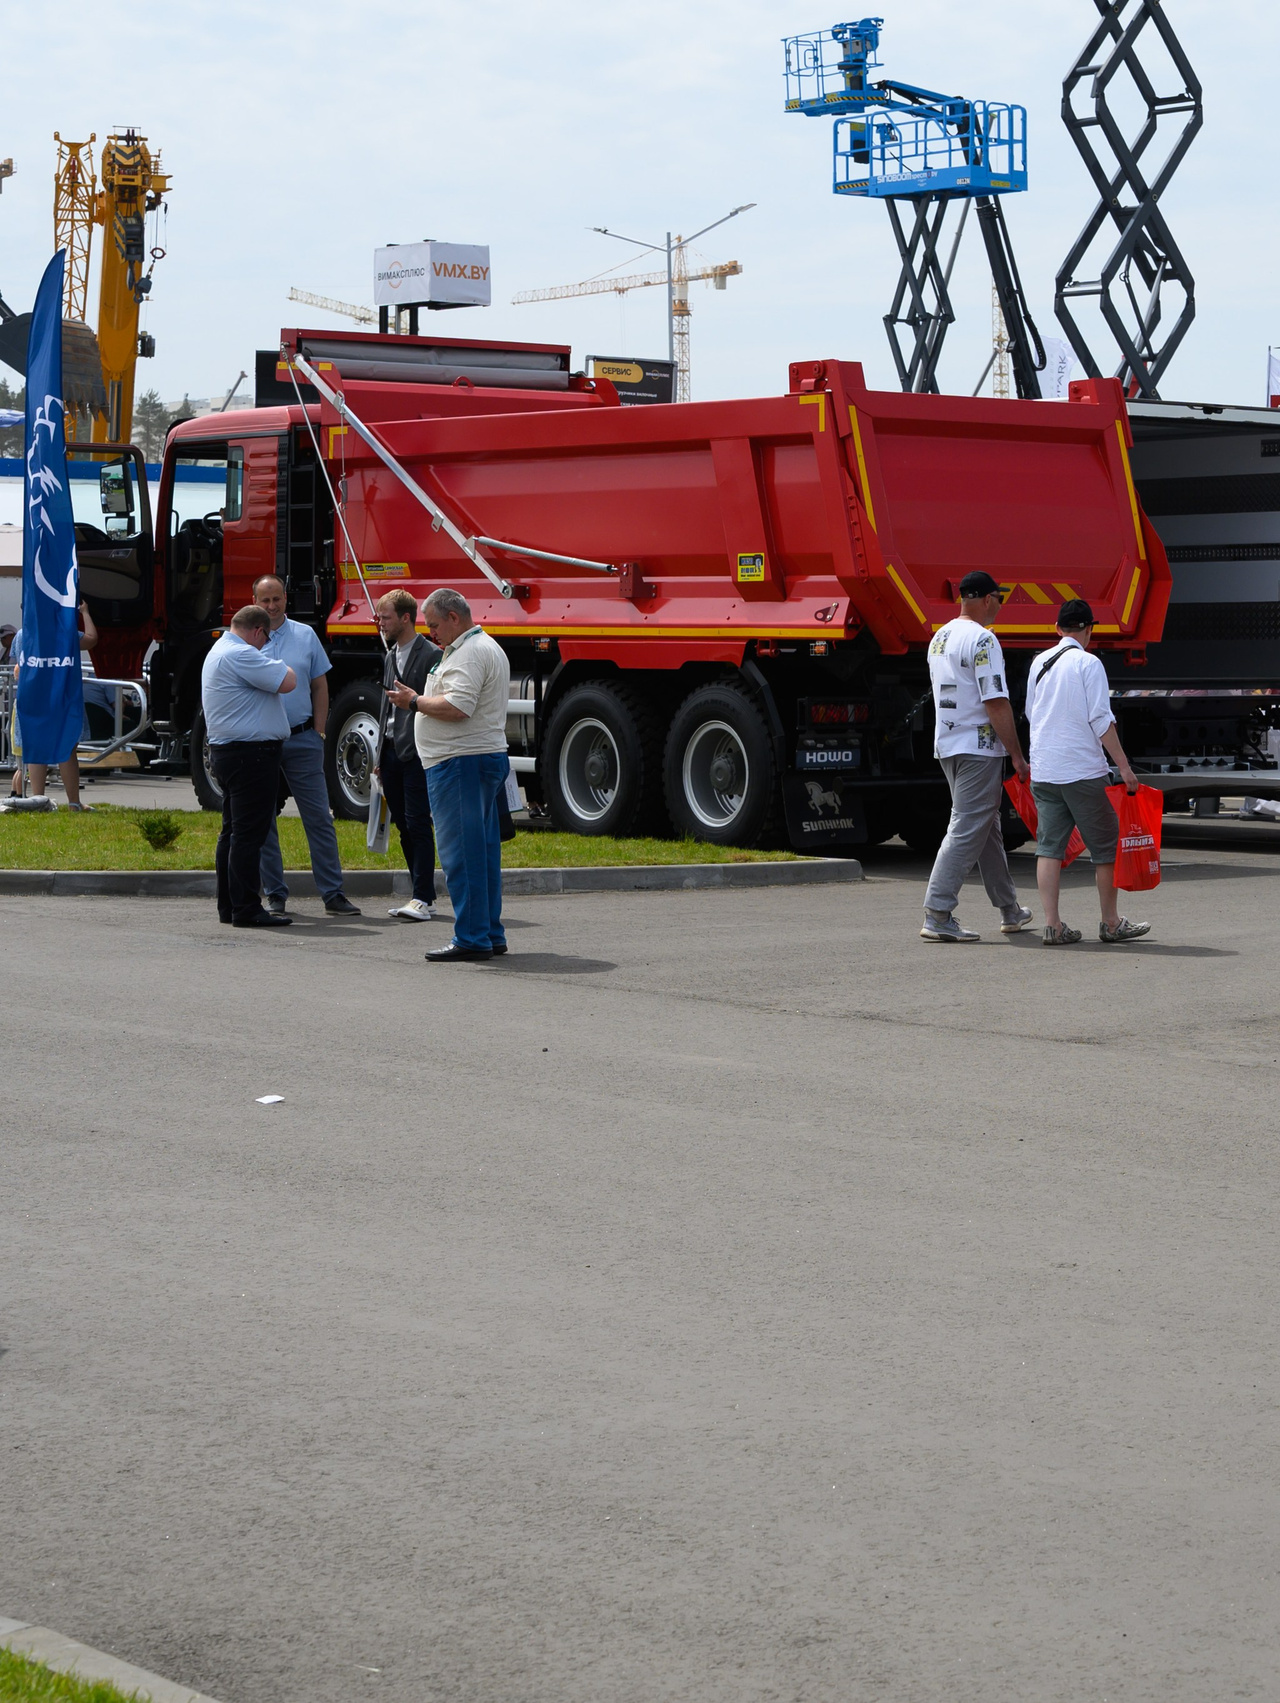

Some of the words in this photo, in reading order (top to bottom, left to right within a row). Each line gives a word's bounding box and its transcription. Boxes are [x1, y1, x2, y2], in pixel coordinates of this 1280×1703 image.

[377, 267, 425, 281] ВИМАКСПЛЮС
[432, 262, 490, 281] VMX.BY
[601, 366, 632, 376] СЕРВИС
[805, 750, 853, 763] HOWO
